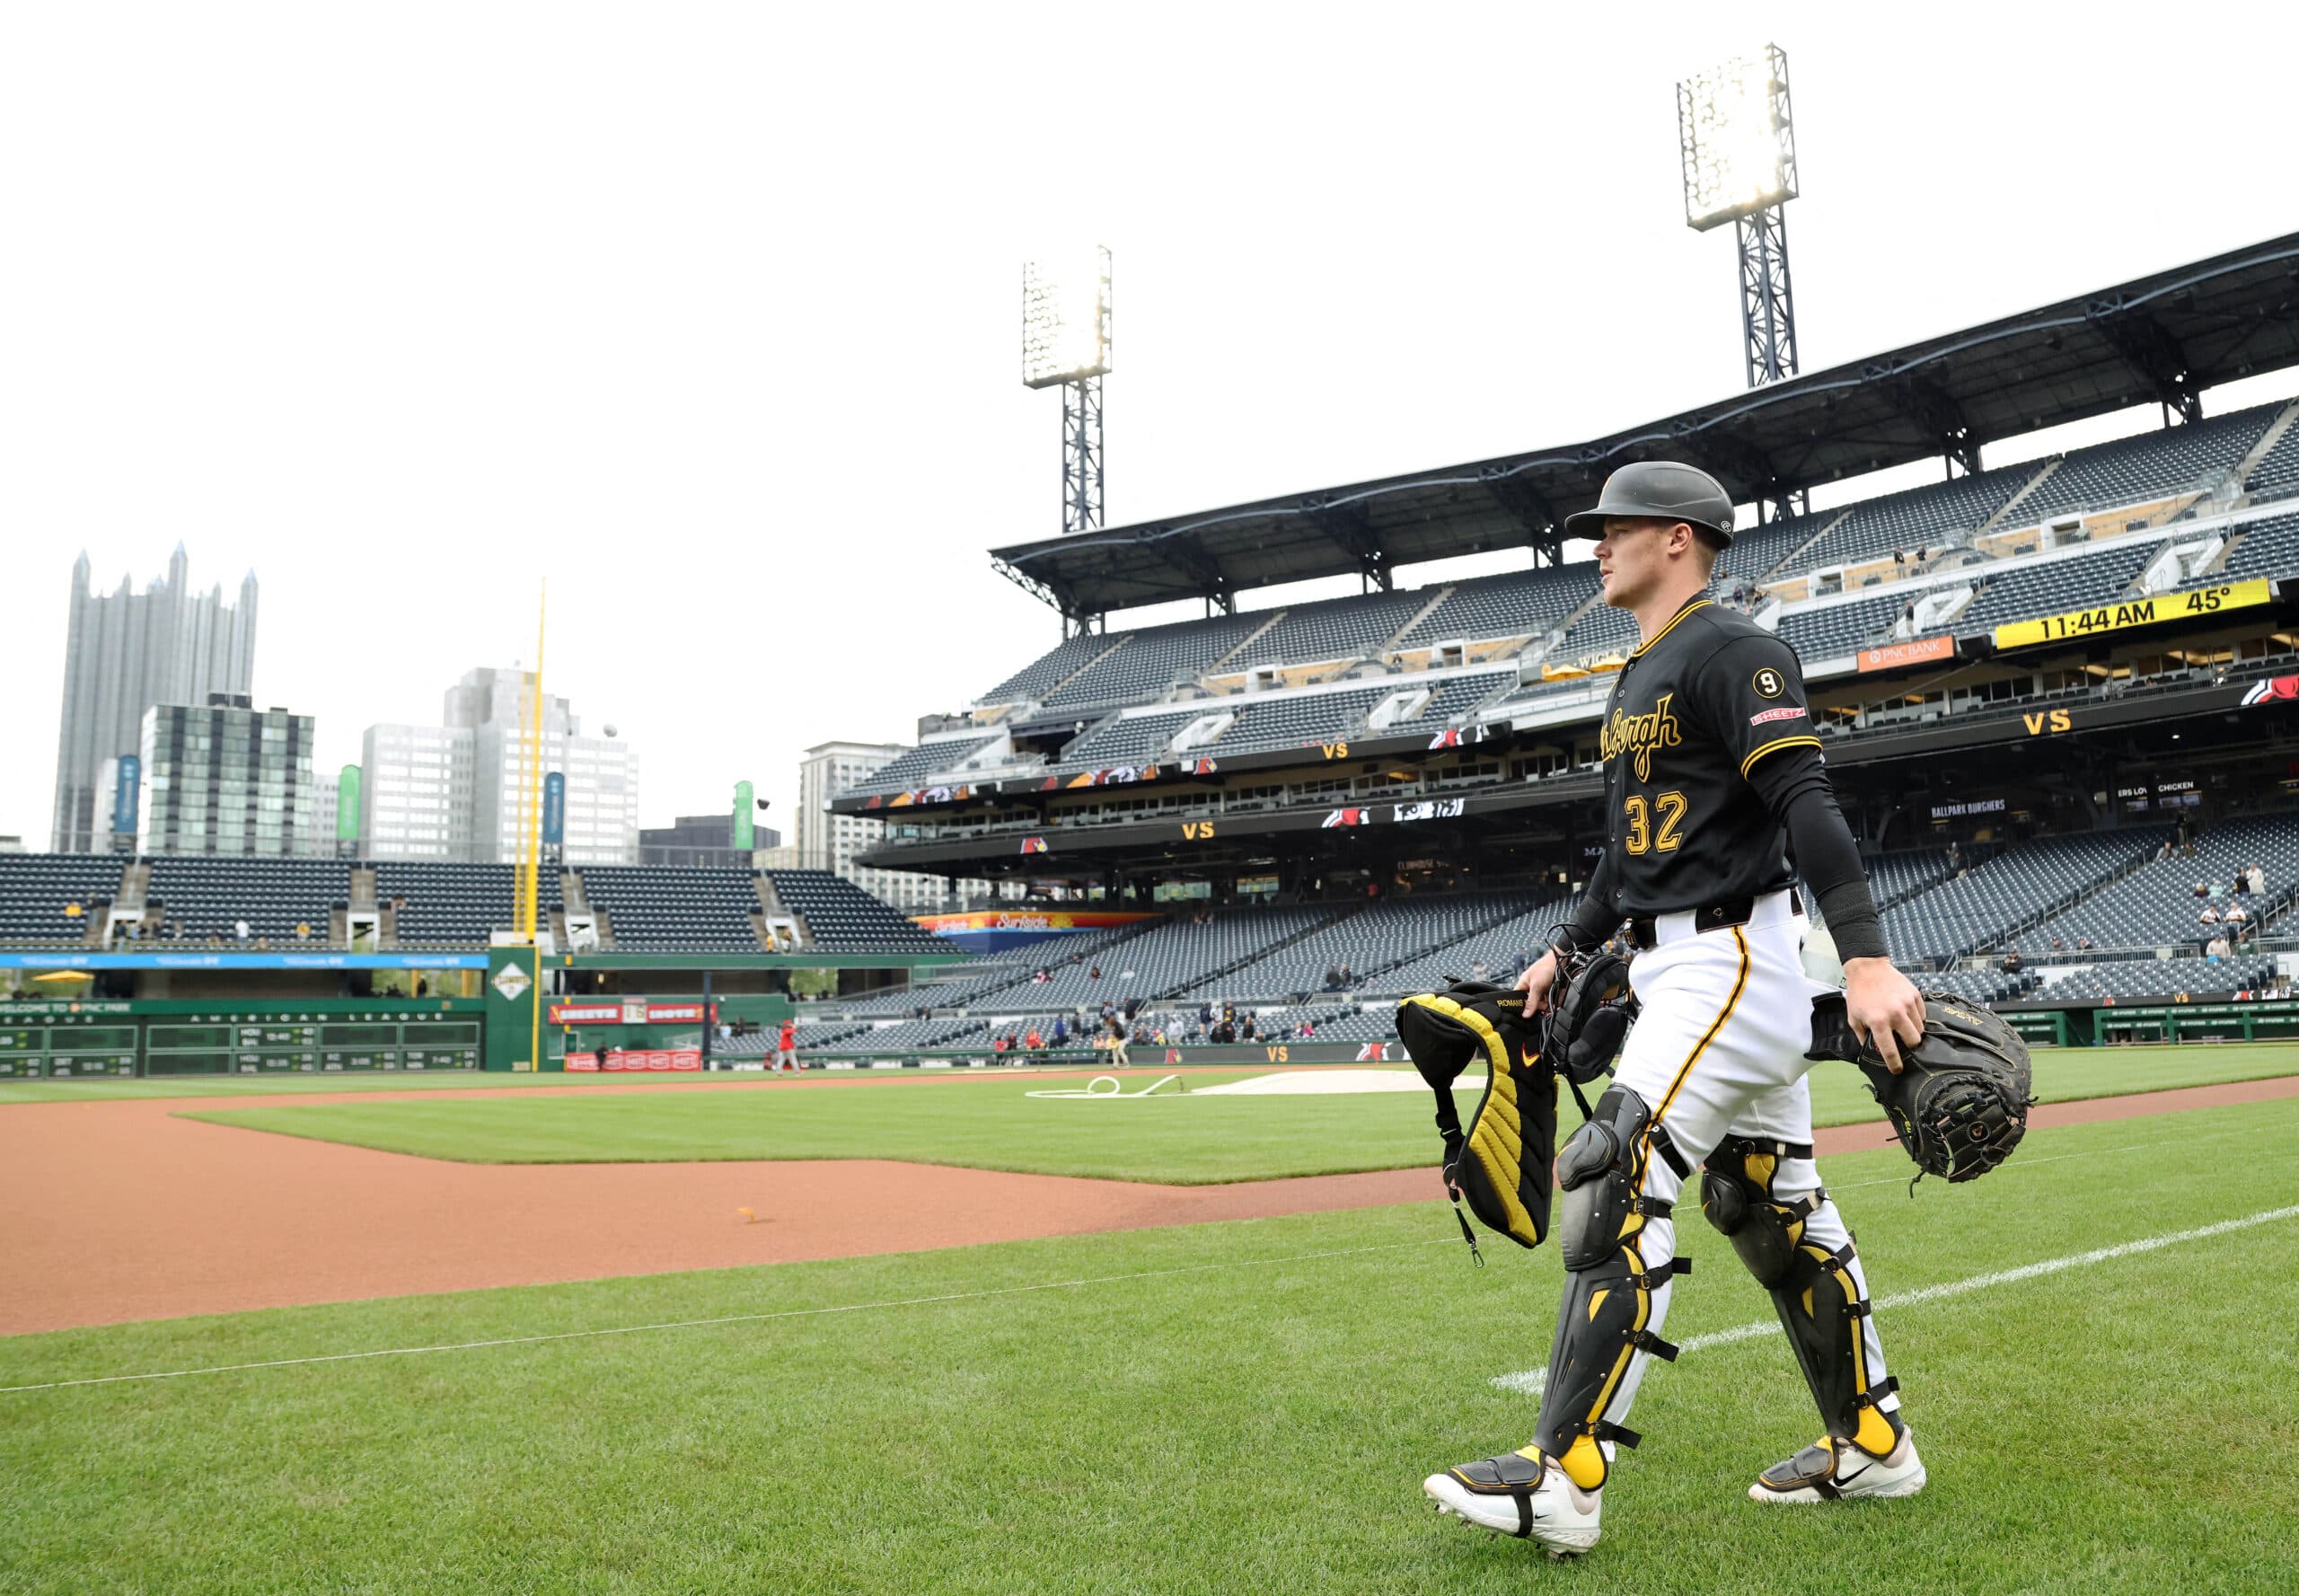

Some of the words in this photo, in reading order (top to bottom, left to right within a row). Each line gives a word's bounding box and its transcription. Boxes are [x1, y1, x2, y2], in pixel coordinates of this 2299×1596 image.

[2041, 610, 2110, 639] 11:44
[2116, 602, 2155, 626] AM
[2187, 587, 2230, 612] 45°
[1883, 648, 1904, 661] PNC
[1908, 641, 1940, 655] BANK
[1760, 672, 1777, 693] 9
[1752, 708, 1805, 724] SHEETZ
[2022, 709, 2071, 736] VS
[1322, 743, 1348, 760] VS
[2158, 781, 2194, 792] CHICKEN
[1932, 804, 1967, 818] BALLPARK
[1182, 821, 1214, 840] VS
[1624, 790, 1687, 855] 32
[996, 913, 1048, 930] Surfside
[2174, 993, 2189, 1003] VS
[1266, 1045, 1288, 1063] VS
